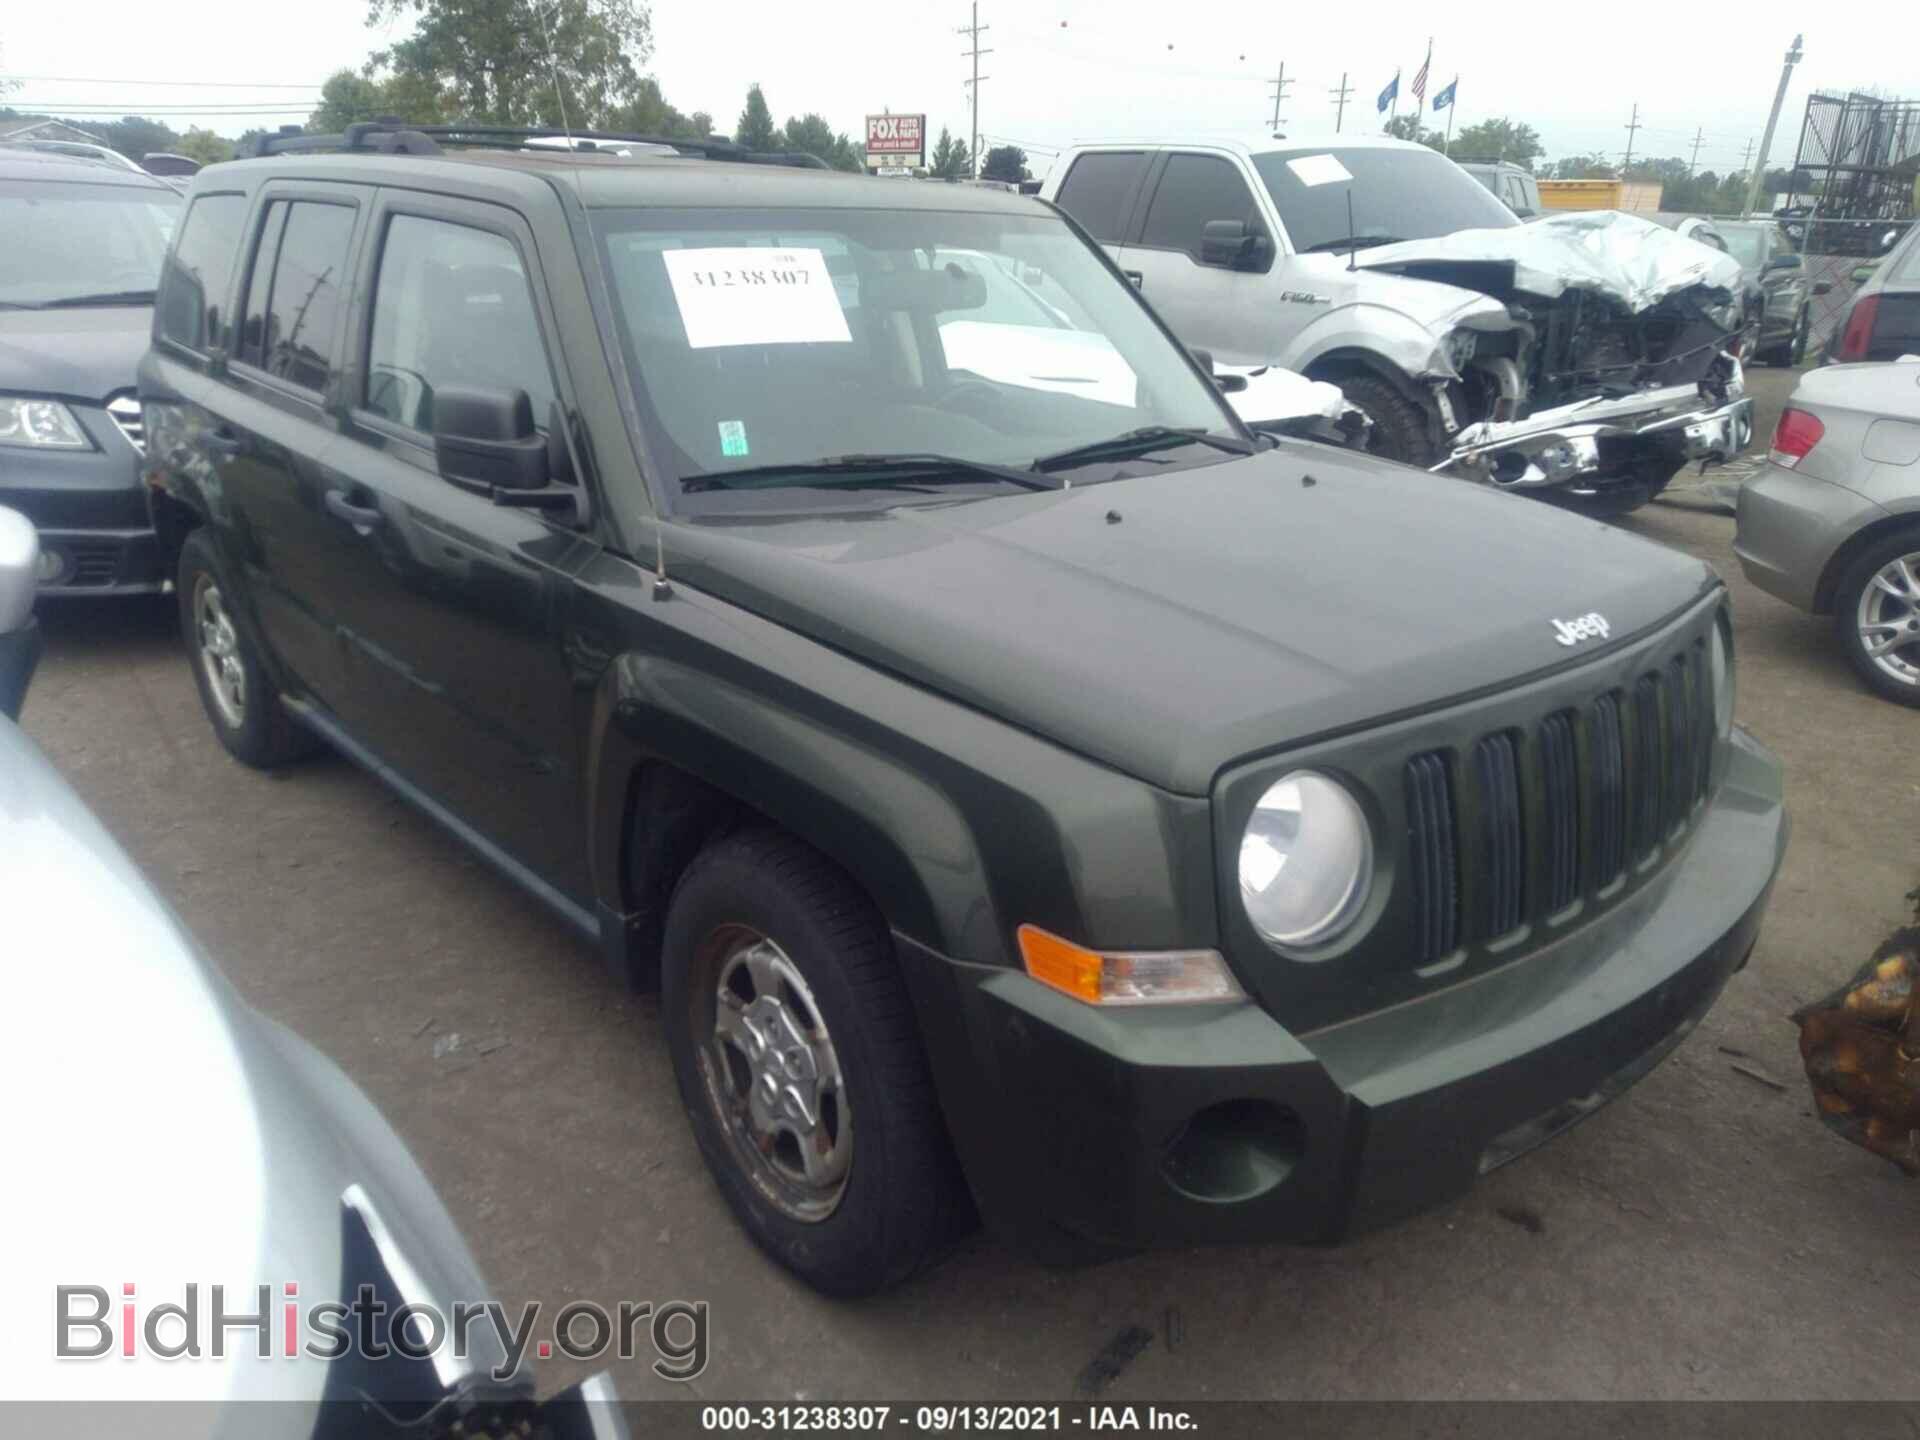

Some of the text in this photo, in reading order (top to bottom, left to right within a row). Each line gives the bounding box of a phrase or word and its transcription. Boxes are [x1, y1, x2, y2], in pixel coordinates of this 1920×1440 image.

[869, 119, 898, 139] FOX
[900, 119, 918, 128] AUTO
[900, 128, 919, 138] PARTS
[694, 270, 809, 287] 31238307
[1552, 613, 1610, 645] Jeep
